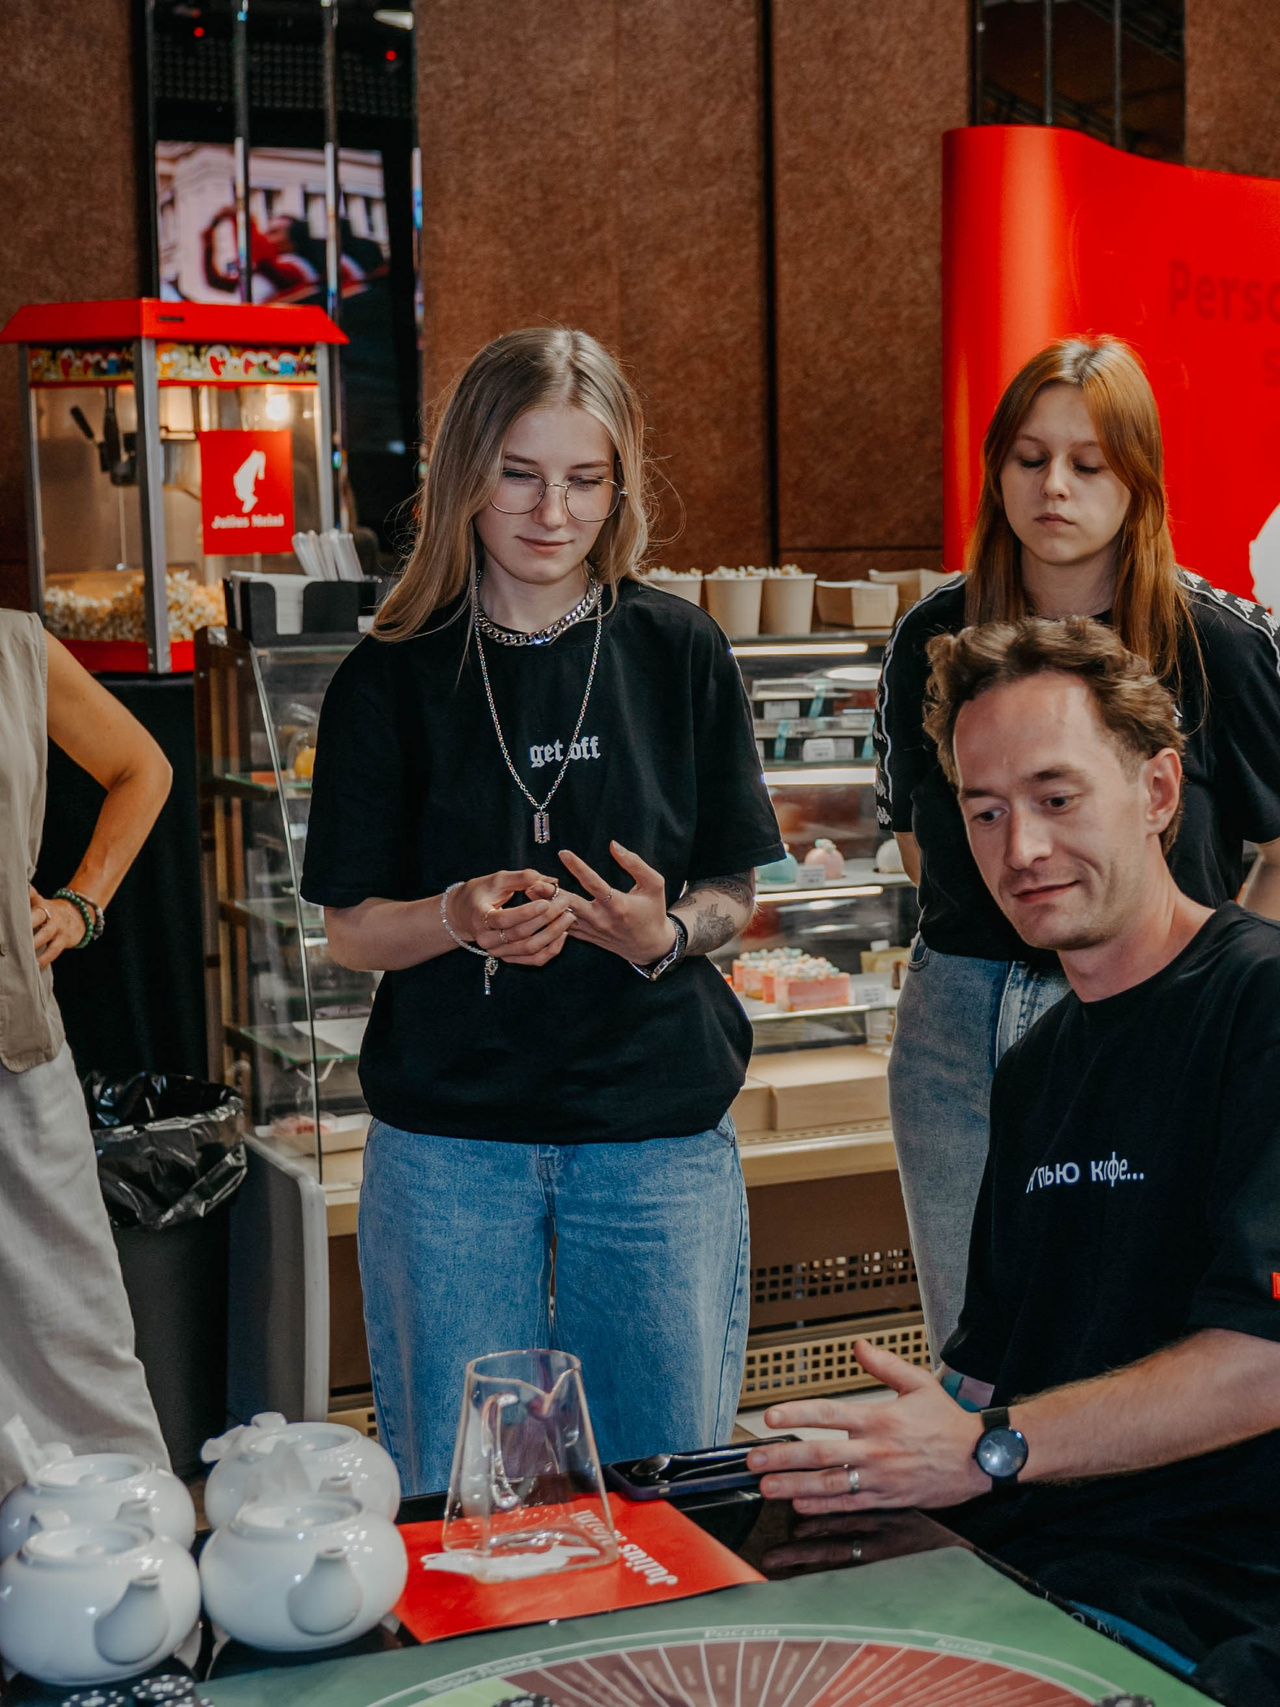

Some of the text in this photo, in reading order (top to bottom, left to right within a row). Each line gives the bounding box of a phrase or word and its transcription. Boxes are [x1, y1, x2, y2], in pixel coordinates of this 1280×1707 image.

[529, 735, 601, 769] get off
[617, 1543, 679, 1586] Julius
